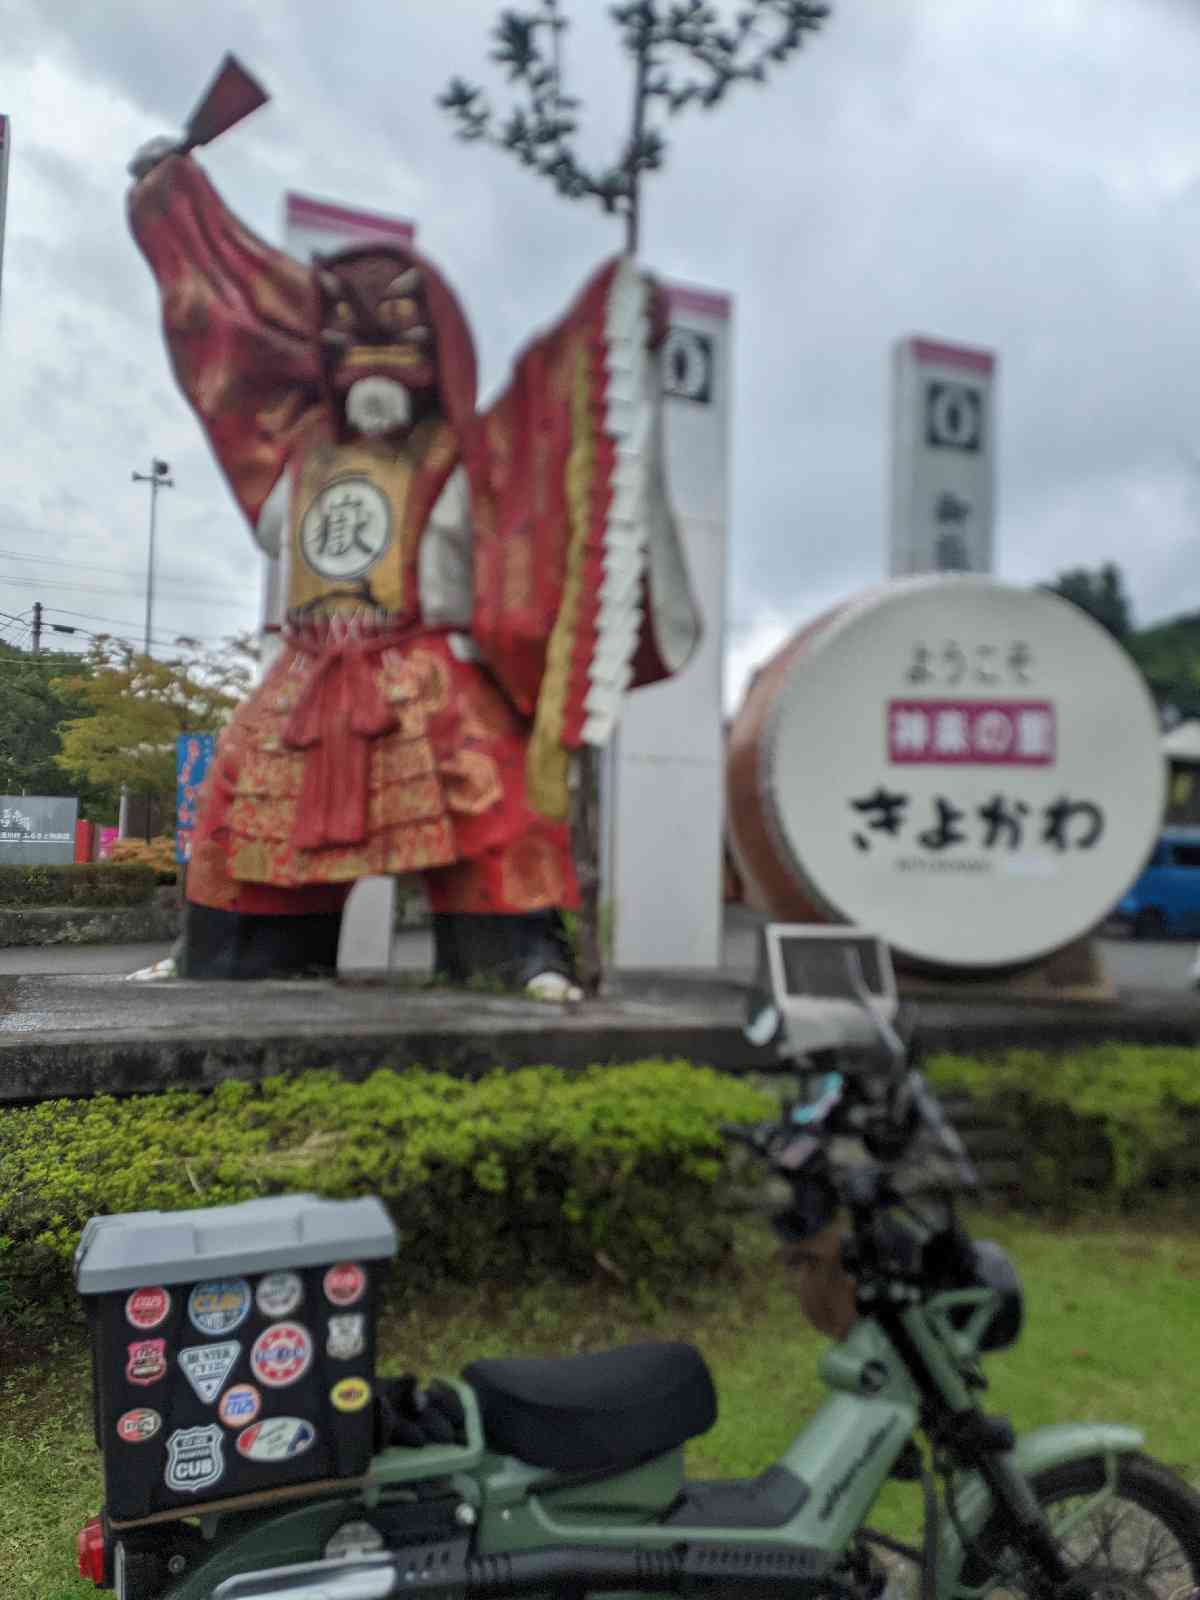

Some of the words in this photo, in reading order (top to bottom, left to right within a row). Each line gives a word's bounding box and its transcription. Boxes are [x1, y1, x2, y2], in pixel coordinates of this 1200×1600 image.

[906, 639, 1033, 685] ようこそ
[849, 785, 1105, 853] きよかわ
[175, 1457, 214, 1480] CUB
